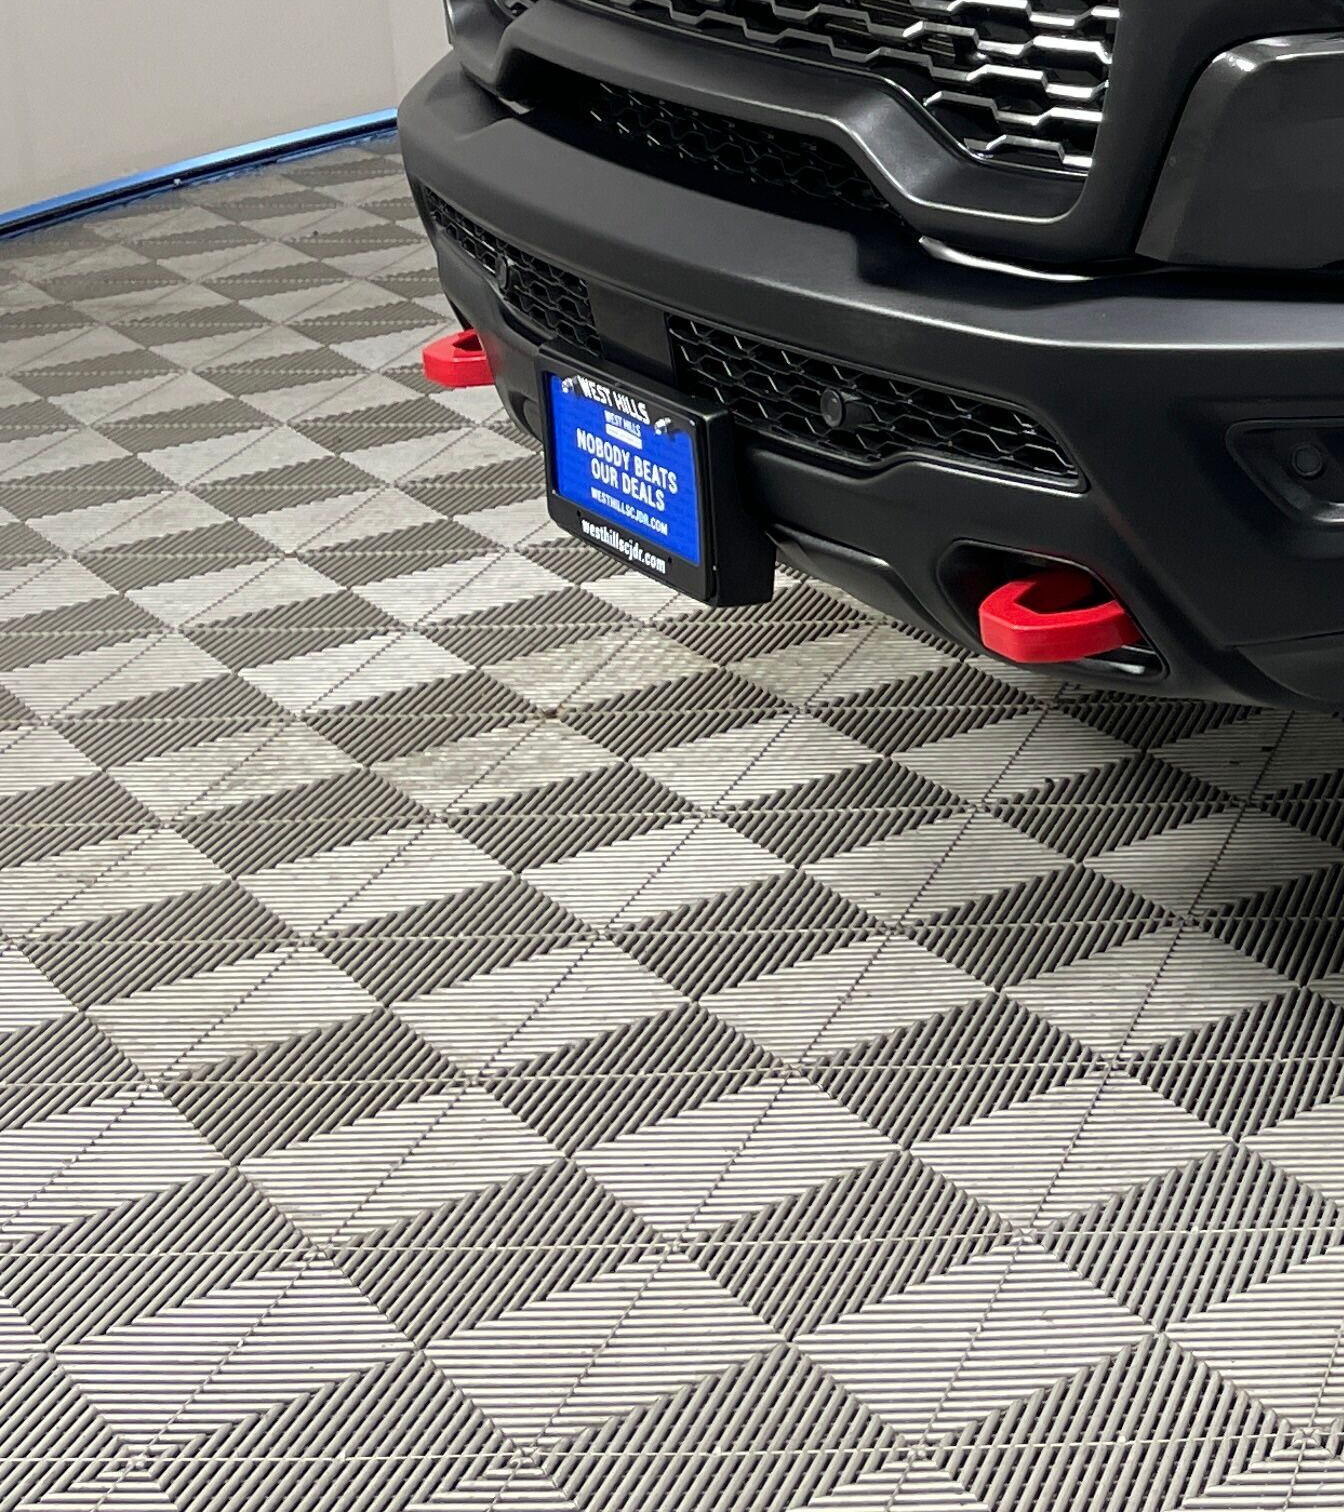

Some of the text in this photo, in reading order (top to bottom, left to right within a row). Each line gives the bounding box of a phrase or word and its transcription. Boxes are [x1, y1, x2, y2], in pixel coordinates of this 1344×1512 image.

[579, 377, 650, 425] WEST HILLS
[576, 428, 630, 469] NOBODY
[634, 455, 677, 494] BEATS
[591, 457, 665, 512] OUR DEALS
[582, 519, 666, 574] westhillscjdr.com
